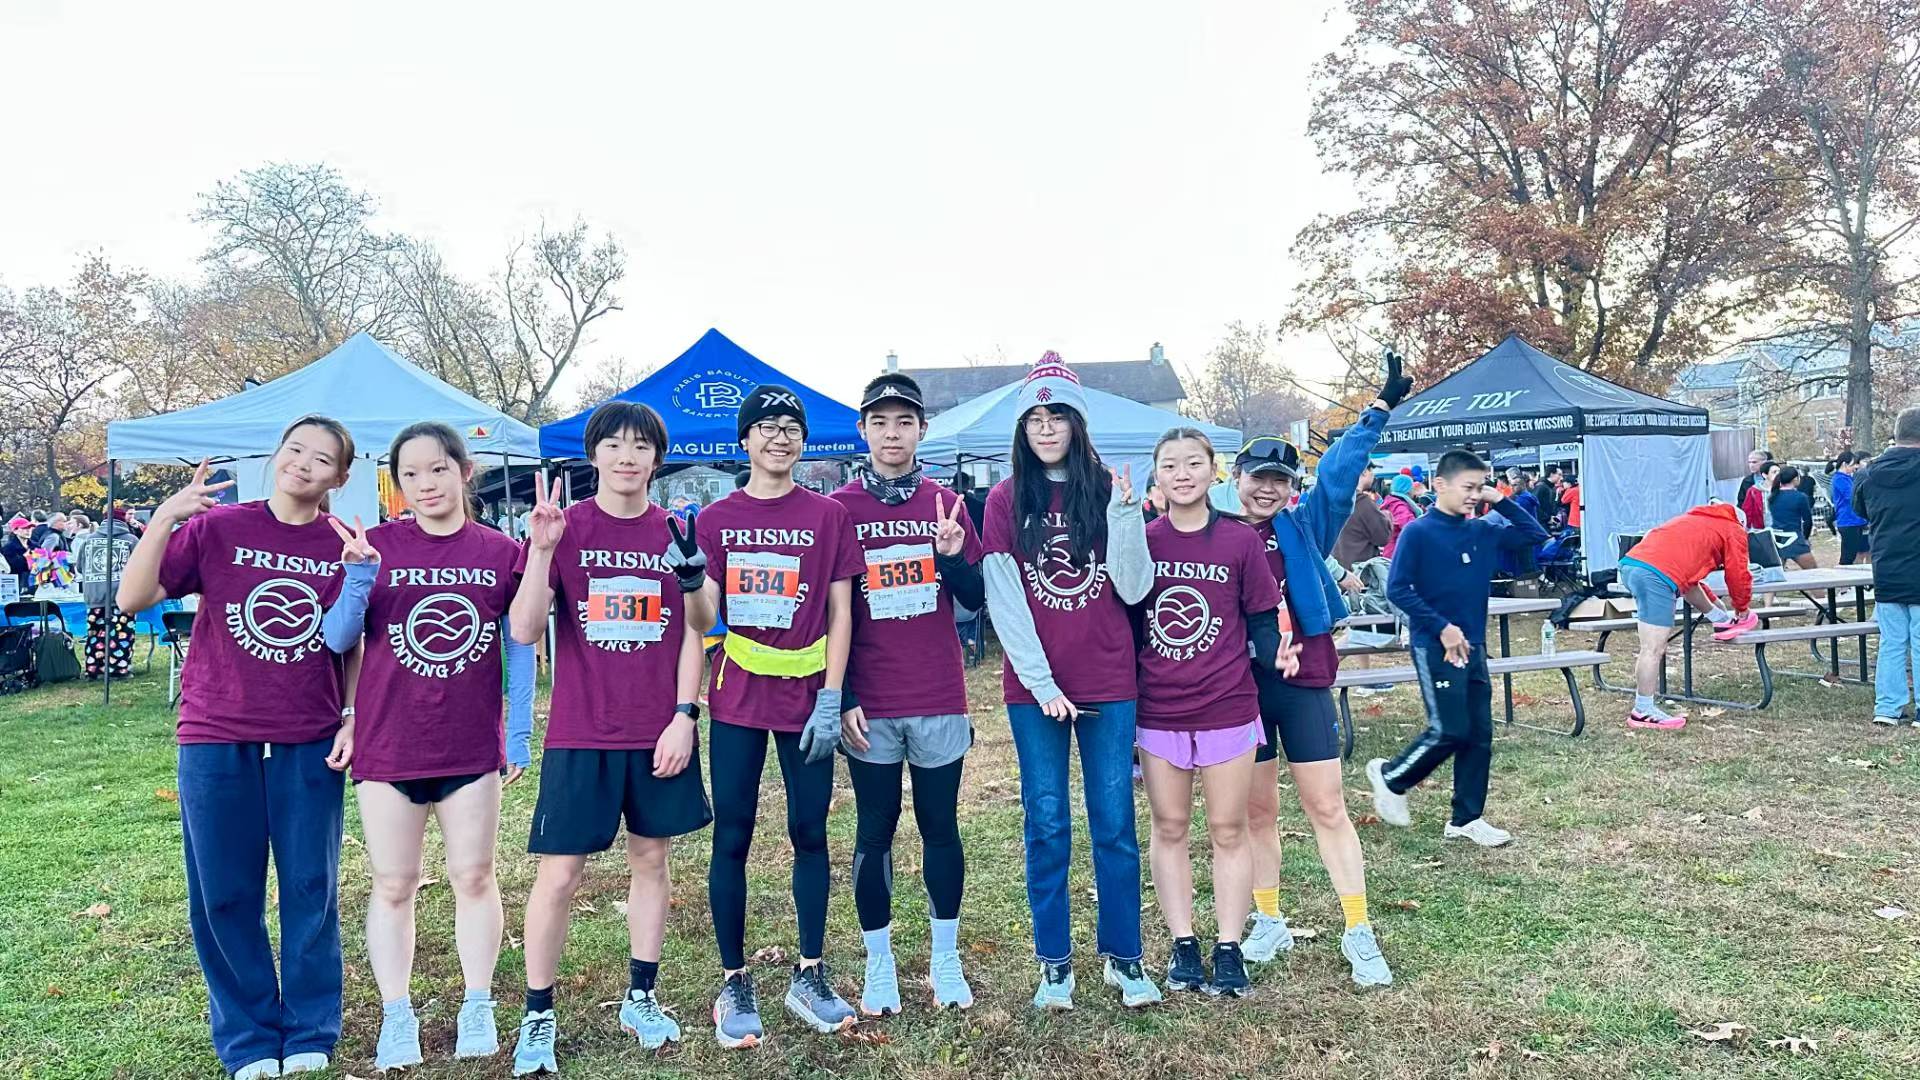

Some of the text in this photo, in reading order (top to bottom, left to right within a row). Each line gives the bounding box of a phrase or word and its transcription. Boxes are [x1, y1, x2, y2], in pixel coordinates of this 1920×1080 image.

[674, 369, 757, 392] PARIS BAGUET
[1406, 390, 1524, 417] THE TOX
[1392, 427, 1440, 443] TREATMENT
[1441, 424, 1464, 438] YOUR
[1465, 422, 1487, 436] BODY
[1489, 420, 1508, 434] HAS
[1509, 419, 1534, 432] BEEN
[1534, 415, 1574, 431] MISSING
[1583, 413, 1594, 427] THE
[667, 443, 855, 455] AGUET inceton
[720, 528, 815, 547] PRISMS
[855, 520, 939, 541] PRISMS
[578, 549, 674, 574] PRISMS
[879, 560, 924, 587] 533
[1155, 561, 1230, 584] RISMS
[388, 567, 498, 587] PRISMS
[739, 569, 786, 595] 534
[1023, 561, 1107, 611] RUNNING CLUB
[604, 594, 649, 621] 531
[225, 602, 325, 664] RUNNING CL
[1197, 616, 1223, 652] CLUB
[388, 621, 497, 678] RUNNING CLUB
